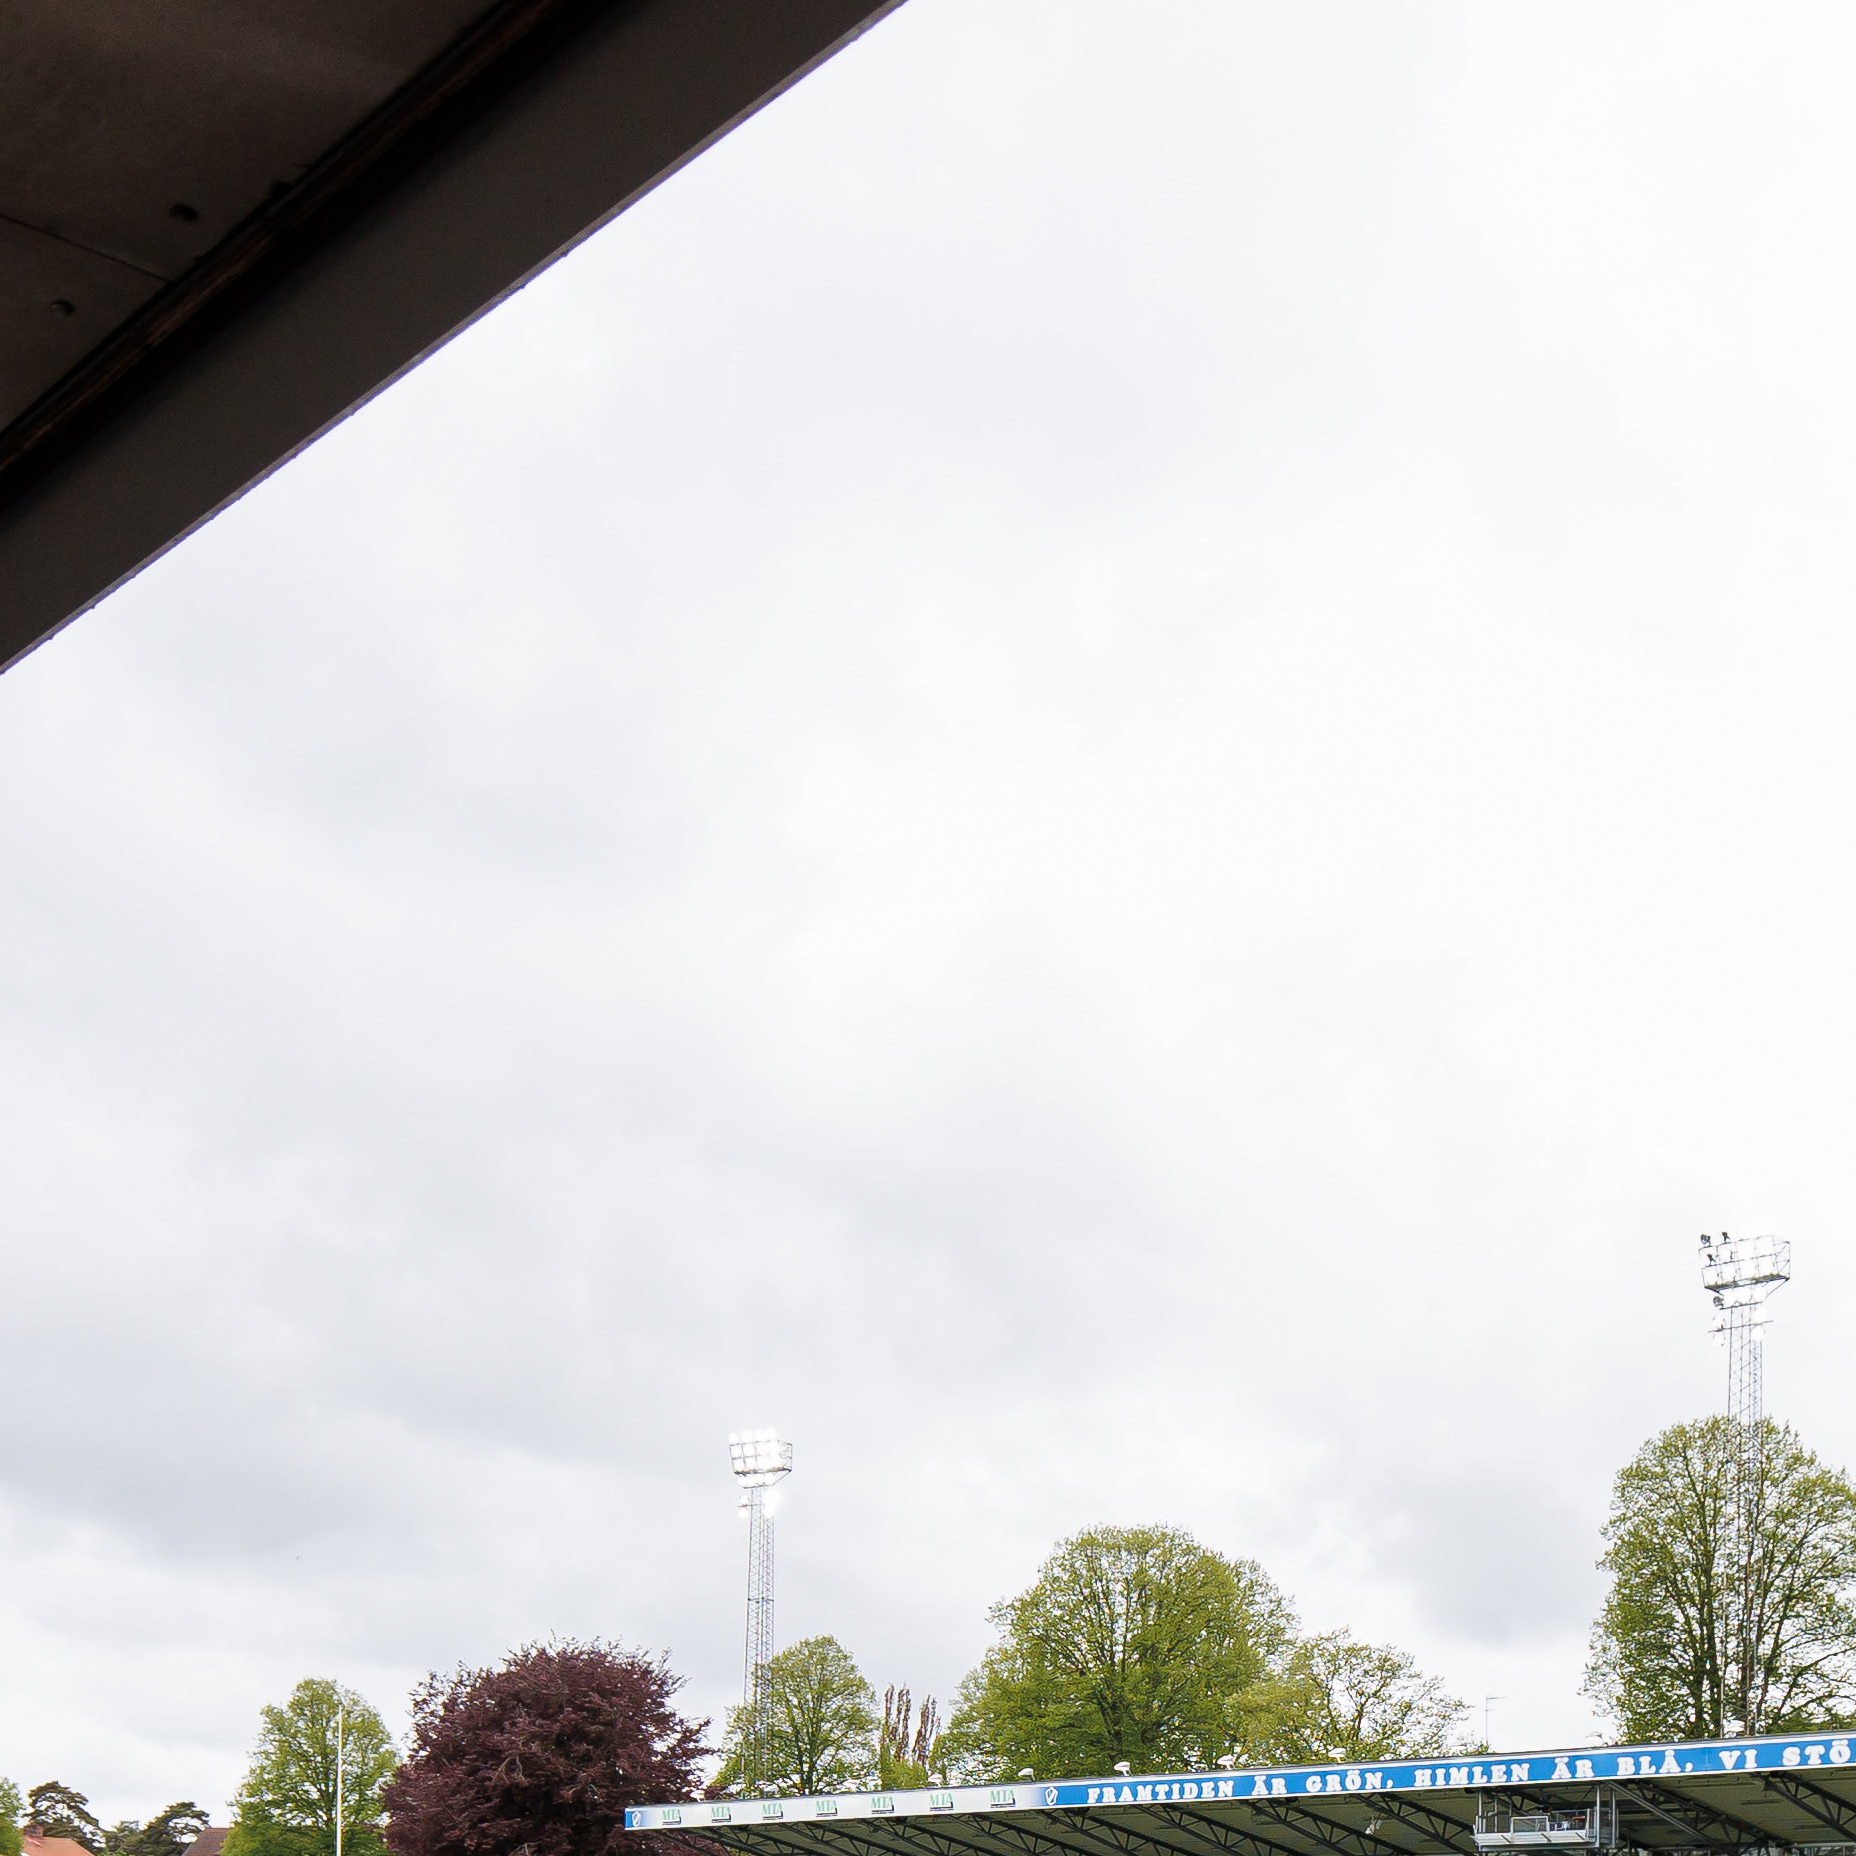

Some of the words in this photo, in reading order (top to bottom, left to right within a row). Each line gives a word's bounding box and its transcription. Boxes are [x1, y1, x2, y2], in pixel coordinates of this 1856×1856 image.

[1087, 1780, 1234, 1804] FRAMTIDEN
[1251, 1767, 1287, 1796] ÄR
[1306, 1768, 1393, 1794] GRÖN,
[1414, 1762, 1530, 1787] HIMLEN
[1550, 1756, 1594, 1780] ÄR
[1616, 1749, 1693, 1775] BLÅ,
[1719, 1749, 1757, 1771] VI
